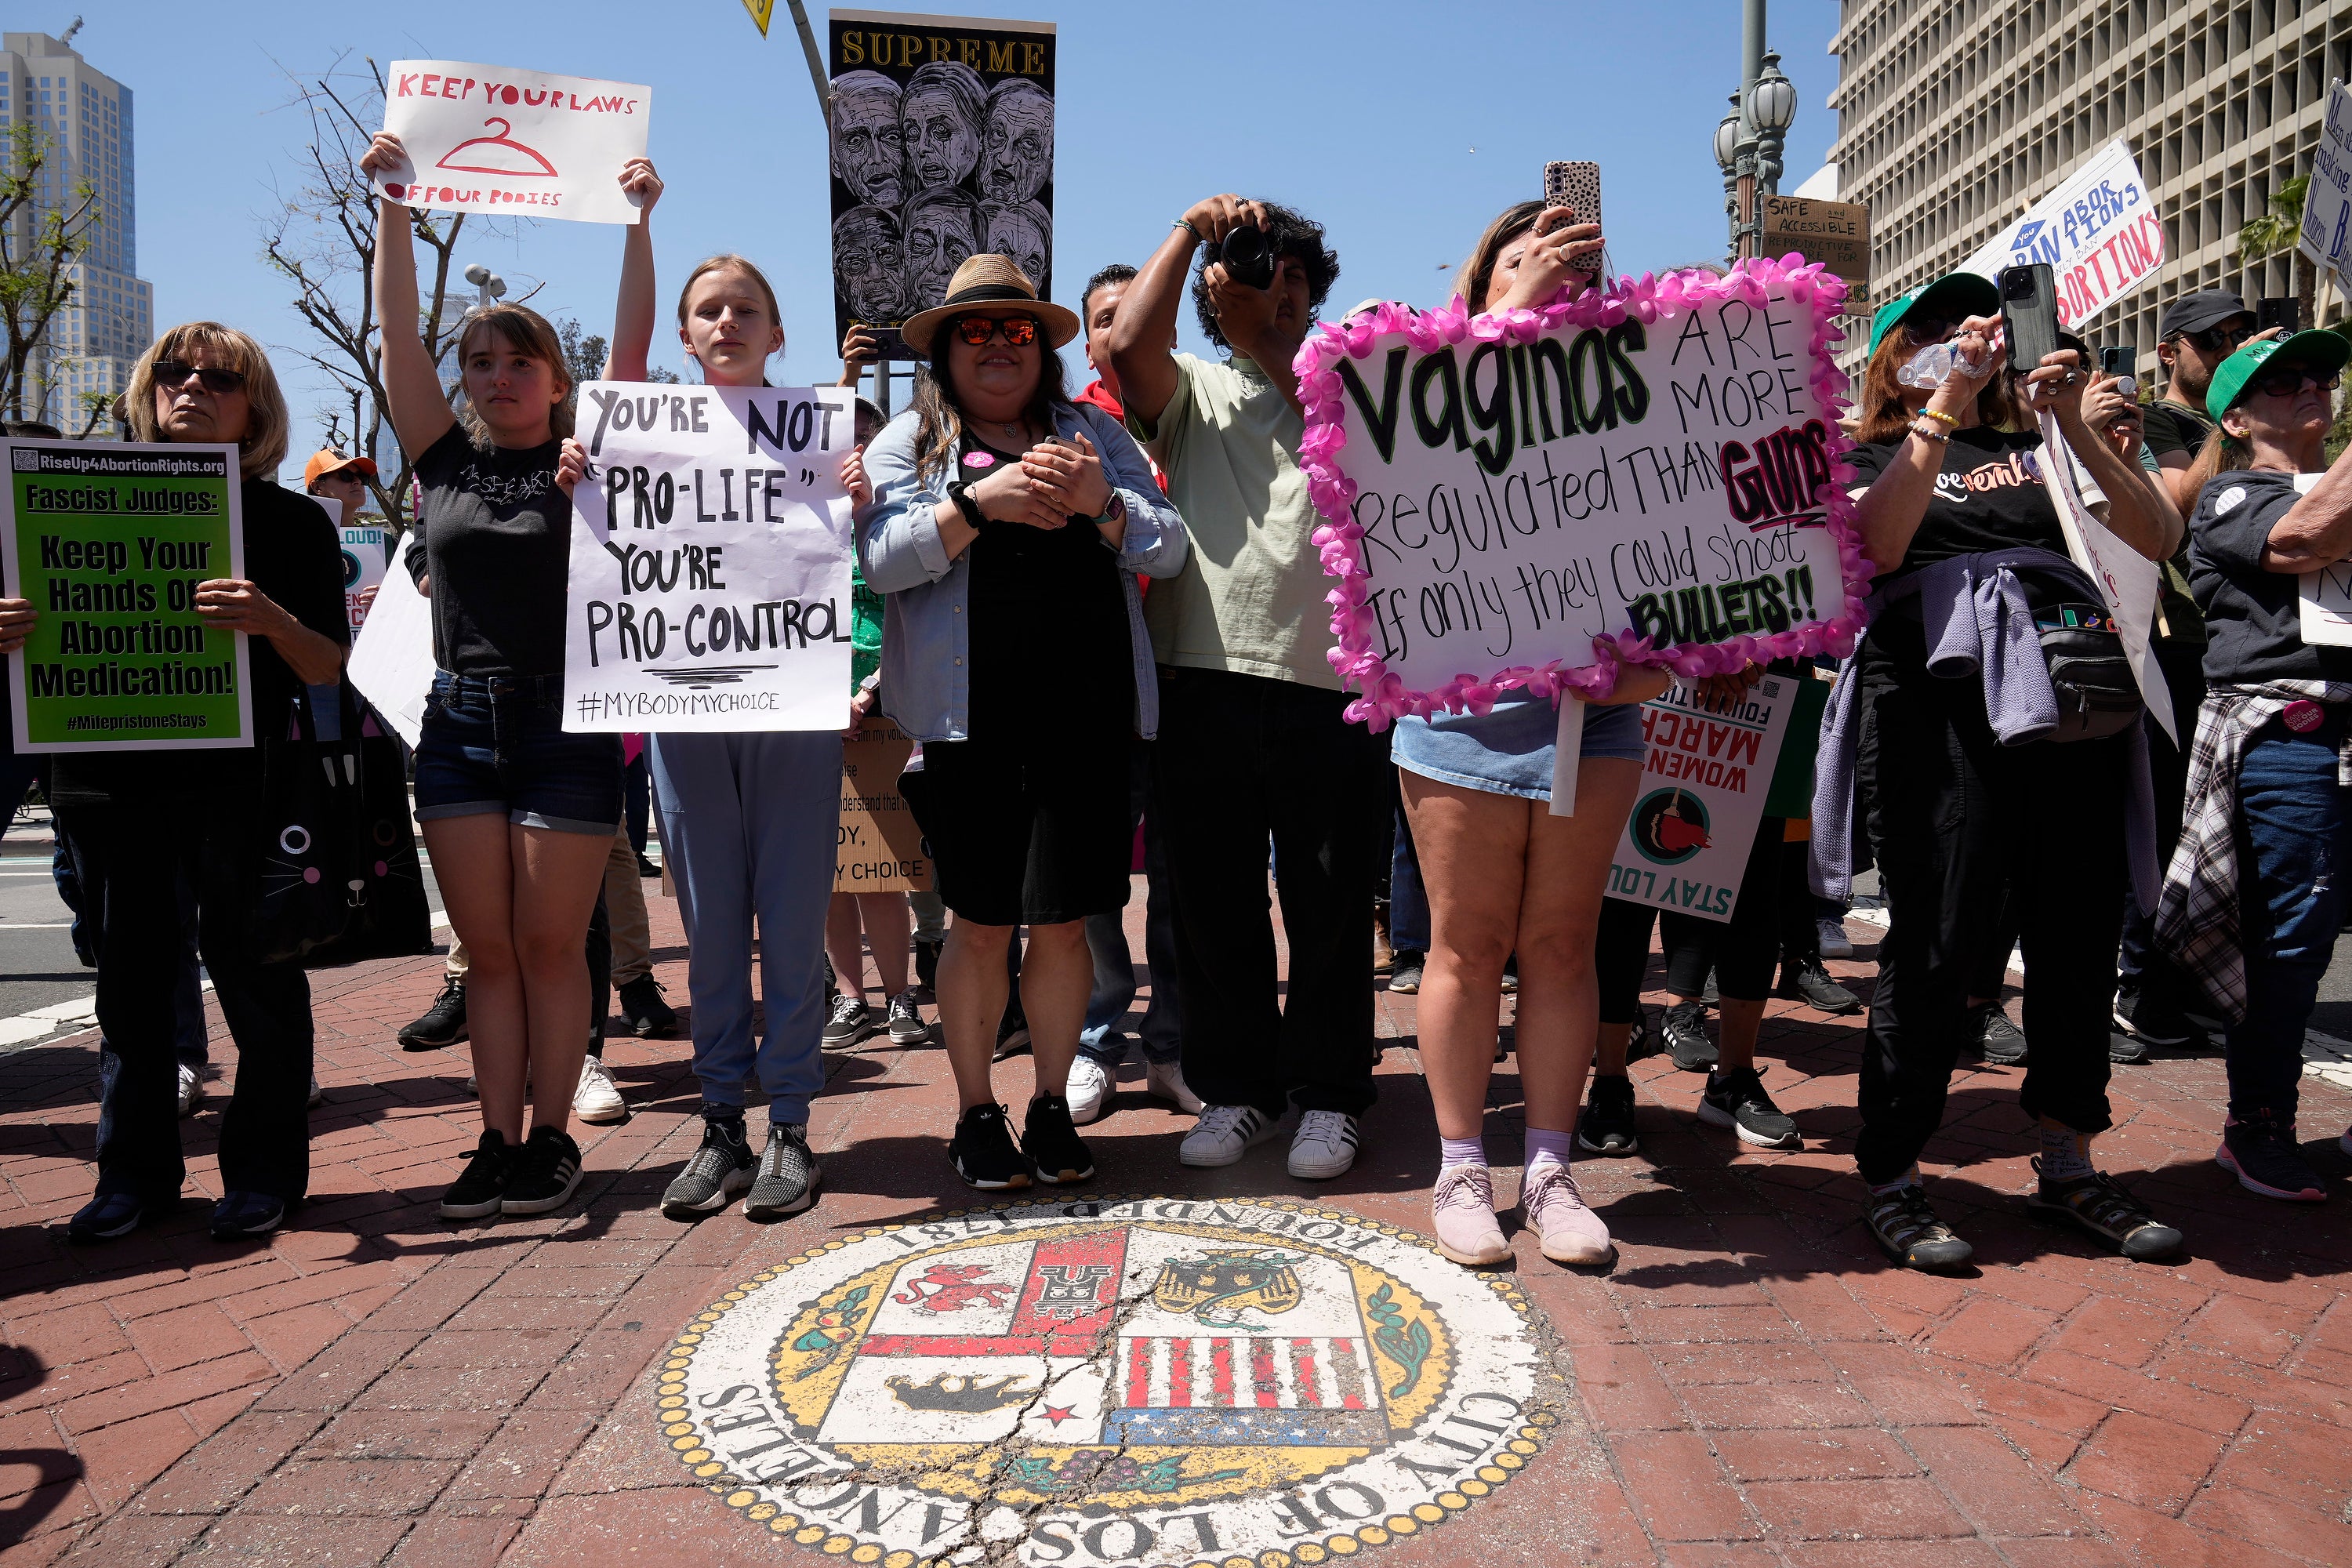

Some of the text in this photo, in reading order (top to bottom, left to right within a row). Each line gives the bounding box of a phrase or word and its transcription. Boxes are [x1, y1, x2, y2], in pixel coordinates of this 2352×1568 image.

[841, 30, 1044, 75] SUPREME
[397, 73, 475, 100] KEEP
[2327, 90, 2344, 141] Men
[2316, 143, 2351, 194] making
[489, 189, 562, 206] BODIES
[1768, 198, 1845, 218] SAFE and
[2063, 180, 2118, 234] ABOR
[2064, 182, 2140, 249] TIONS
[2303, 172, 2326, 249] Women's
[1769, 237, 1853, 251] REPRODUCTIVE
[1780, 218, 1857, 235] ACCESSIBLE
[1798, 250, 1858, 262] ARE FOR
[2055, 210, 2165, 326] BORTIONS
[2076, 236, 2099, 260] BAN
[1671, 296, 1794, 372] ARE
[2245, 347, 2266, 358] MY
[1671, 368, 1806, 434] MORE
[588, 388, 844, 457] YOU'RE NOT
[40, 454, 225, 475] RiseUp4AbortionRights.org
[26, 484, 220, 515] Fascist Judges:
[1348, 446, 1619, 578] Regulated
[1617, 440, 1727, 514] THAN
[40, 535, 212, 575] Keep Your
[604, 541, 727, 595] YOU'RE
[48, 578, 205, 613] Hands Of
[1366, 586, 1408, 664] If
[1420, 567, 1513, 657] only
[1512, 557, 1608, 639] they
[1627, 564, 1818, 652] BULLETS!!
[60, 619, 205, 655] Abortion
[586, 598, 851, 667] PRO-CONTROL
[31, 661, 234, 699] Medication!
[67, 714, 207, 731] #MifepristoneStays
[577, 691, 780, 722] #MYBODYMYCHOICE
[2292, 713, 2319, 731] BODIES
[2301, 708, 2318, 719] OUR
[873, 730, 885, 745] my
[838, 792, 880, 811] nderstand
[883, 792, 900, 811] that
[835, 859, 924, 880] Y CHOICE
[1605, 863, 1733, 916] STAY LOU
[887, 1200, 1384, 1253] 1781 FOUNDED
[1385, 1391, 1522, 1493] CITY
[1271, 1480, 1387, 1539] OF
[1029, 1508, 1225, 1563] LOS
